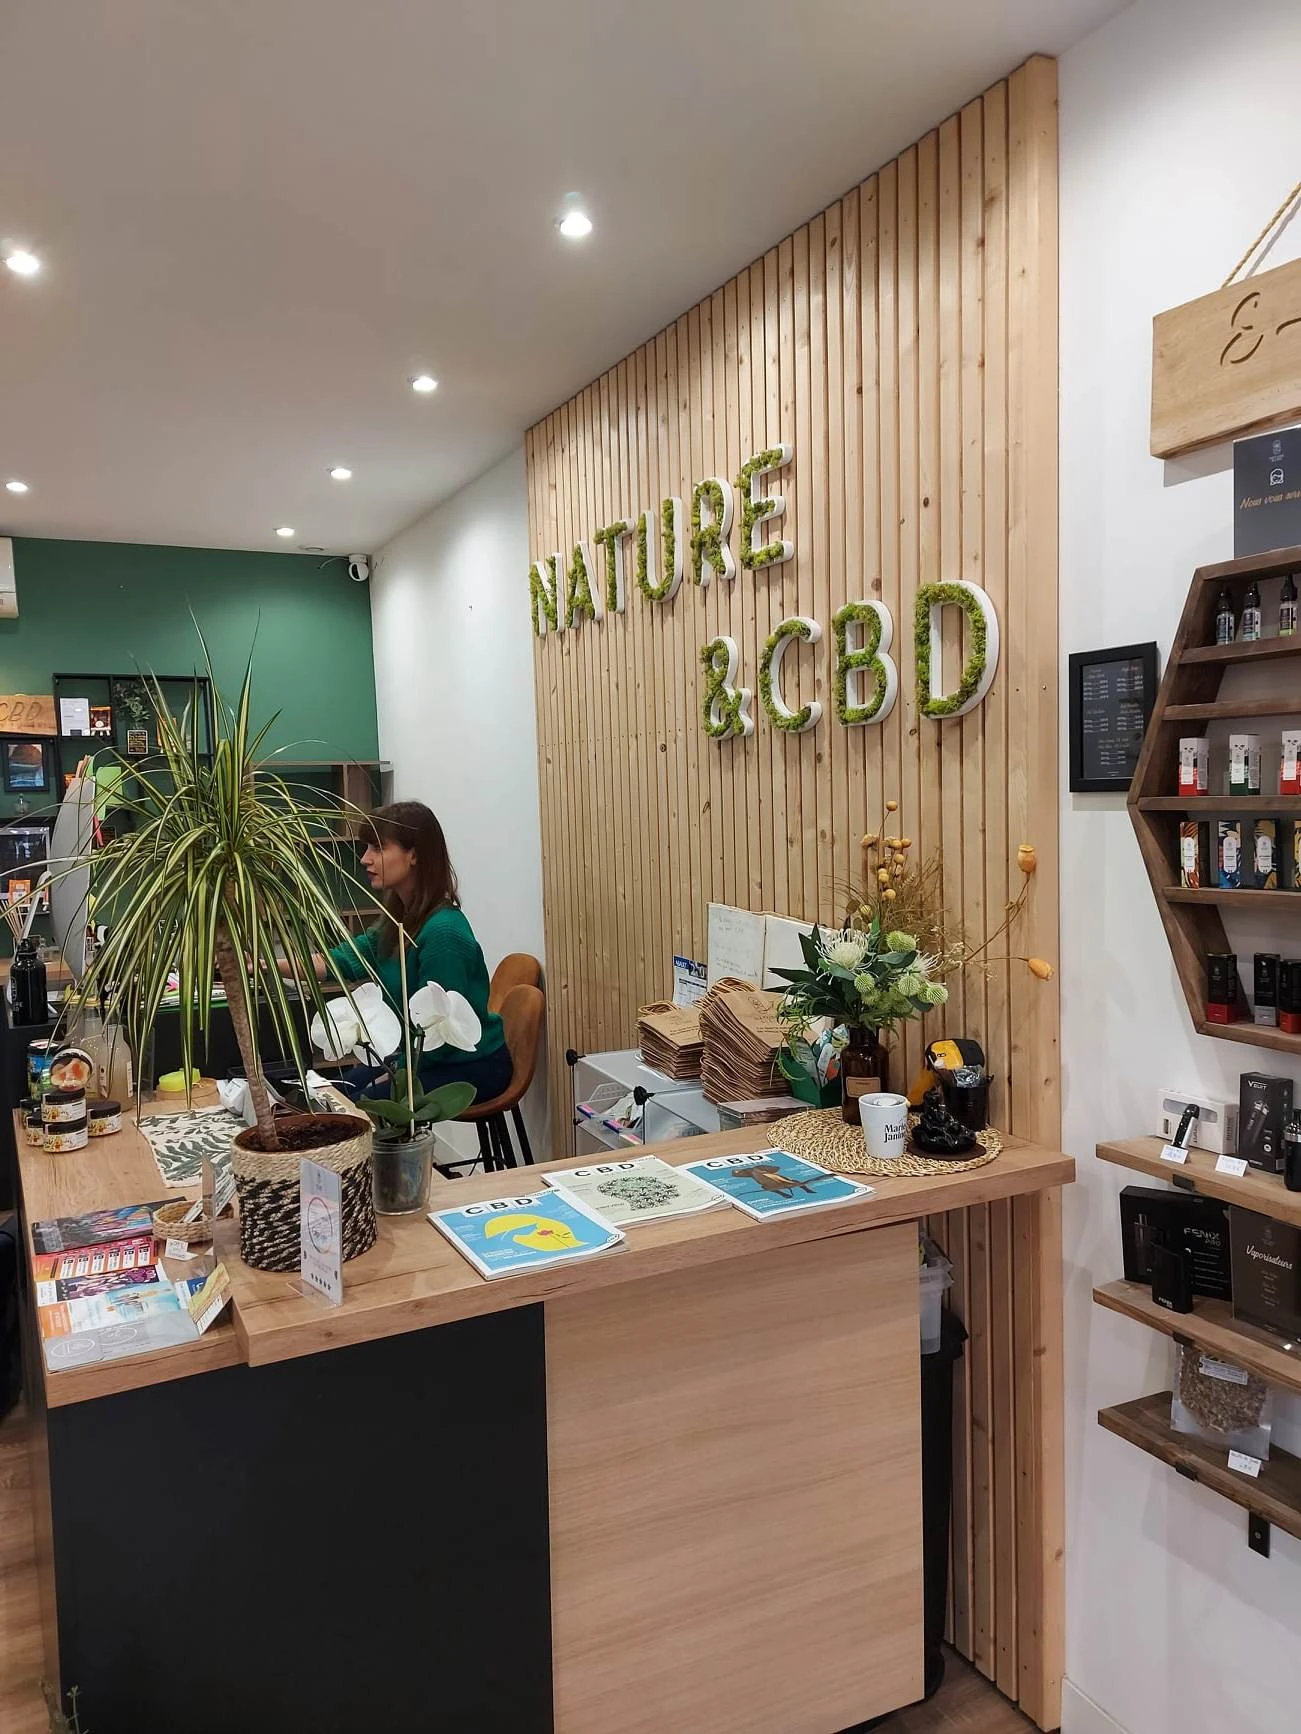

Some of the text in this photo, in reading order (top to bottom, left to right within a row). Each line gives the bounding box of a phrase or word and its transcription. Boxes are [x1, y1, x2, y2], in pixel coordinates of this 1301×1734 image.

[529, 442, 794, 638] NATURE
[704, 1153, 764, 1168] CBD
[574, 1162, 635, 1177] CBD
[465, 1198, 533, 1215] CBD
[1246, 1244, 1293, 1270] Vaporisateurs
